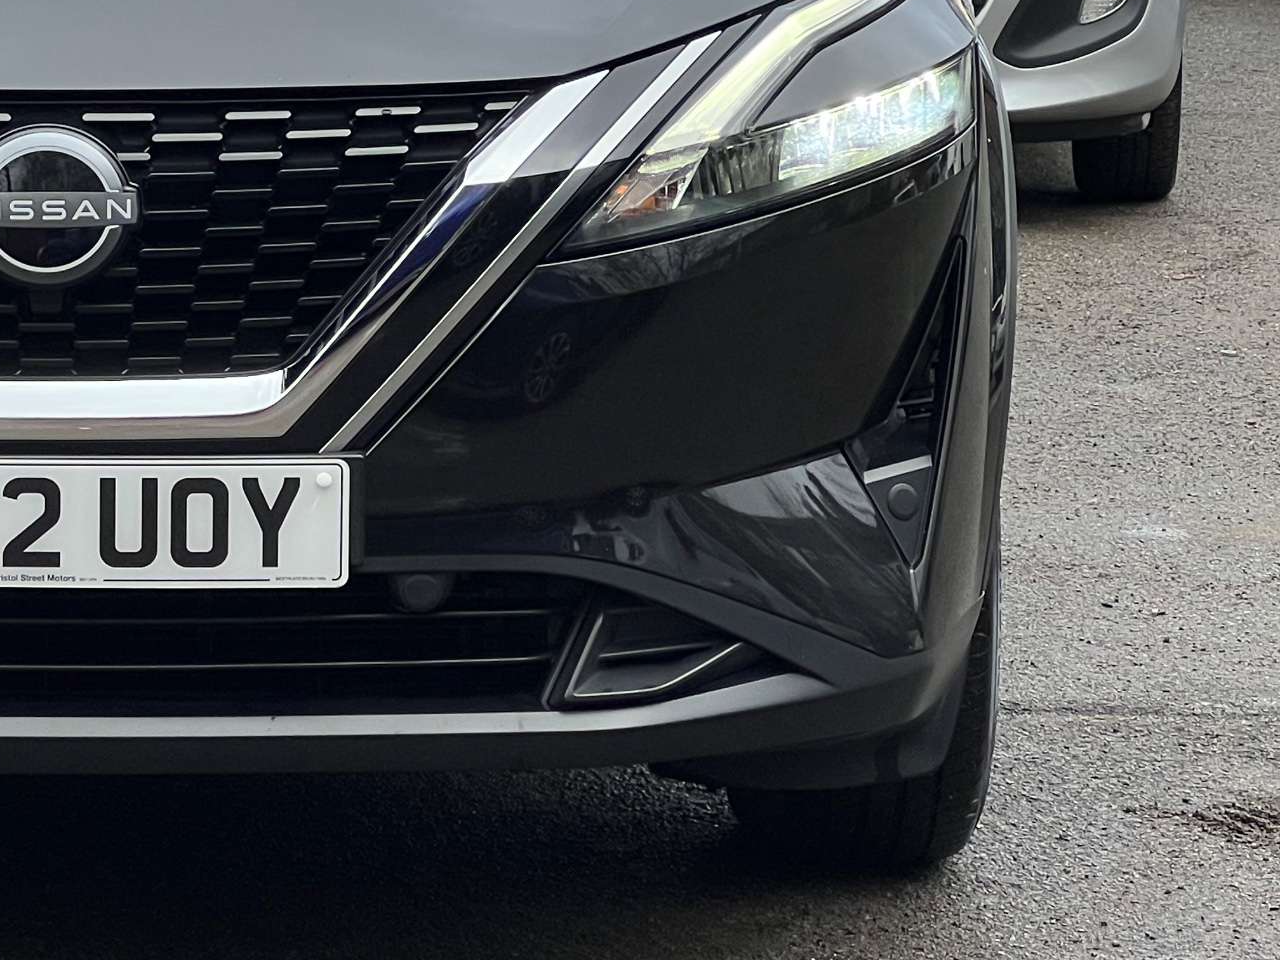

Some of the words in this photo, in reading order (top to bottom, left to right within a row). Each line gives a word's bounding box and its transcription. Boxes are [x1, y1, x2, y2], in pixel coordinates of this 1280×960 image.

[99, 477, 301, 568] UOY
[20, 574, 45, 582] Street
[47, 574, 76, 582] Motors
